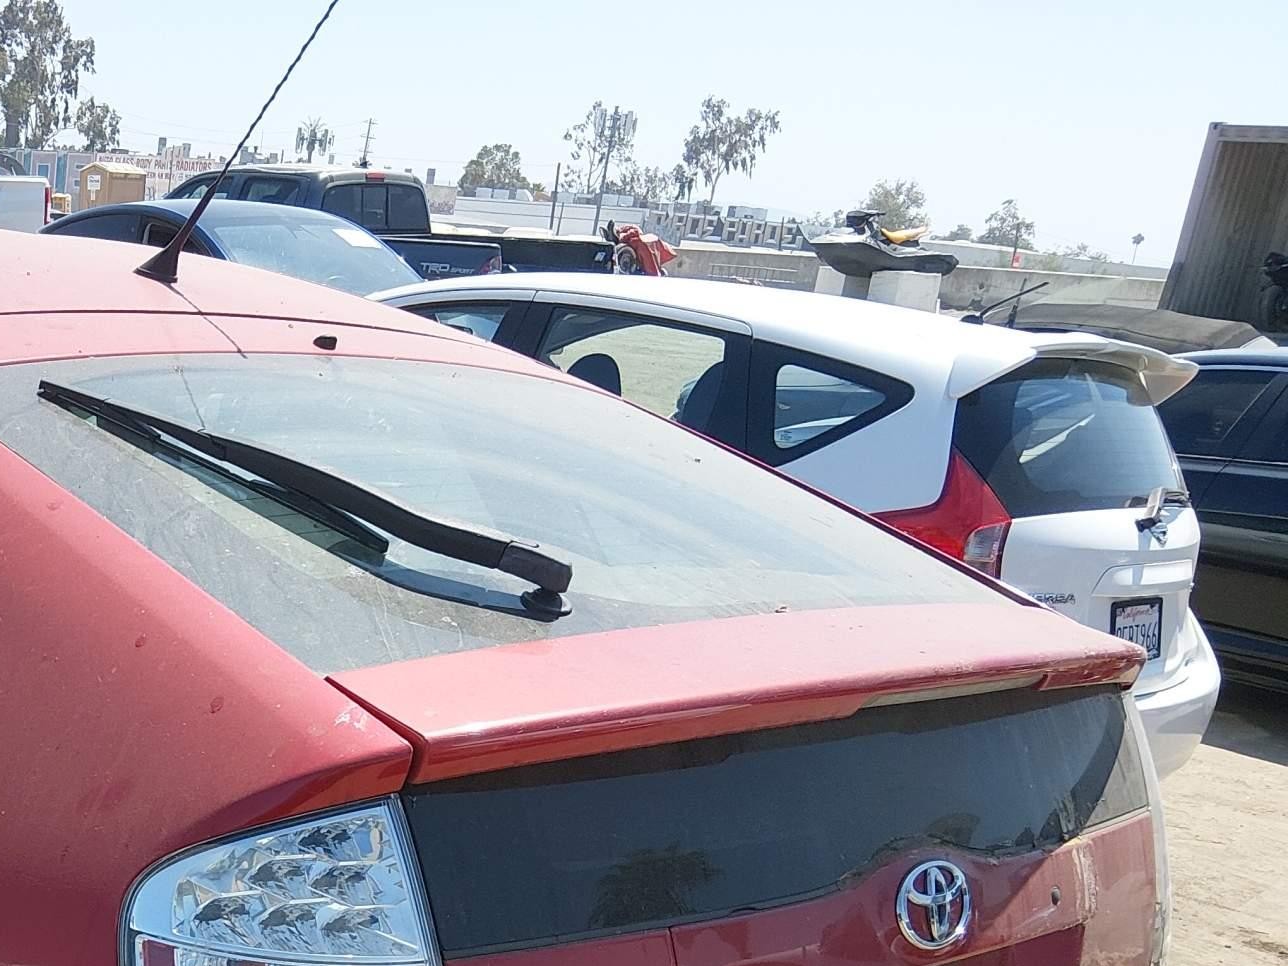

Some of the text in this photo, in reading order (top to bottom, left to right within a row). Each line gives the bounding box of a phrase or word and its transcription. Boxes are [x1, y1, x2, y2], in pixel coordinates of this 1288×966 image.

[136, 158, 152, 168] BODY
[421, 262, 450, 274] TRD
[1030, 592, 1075, 605] ERSA
